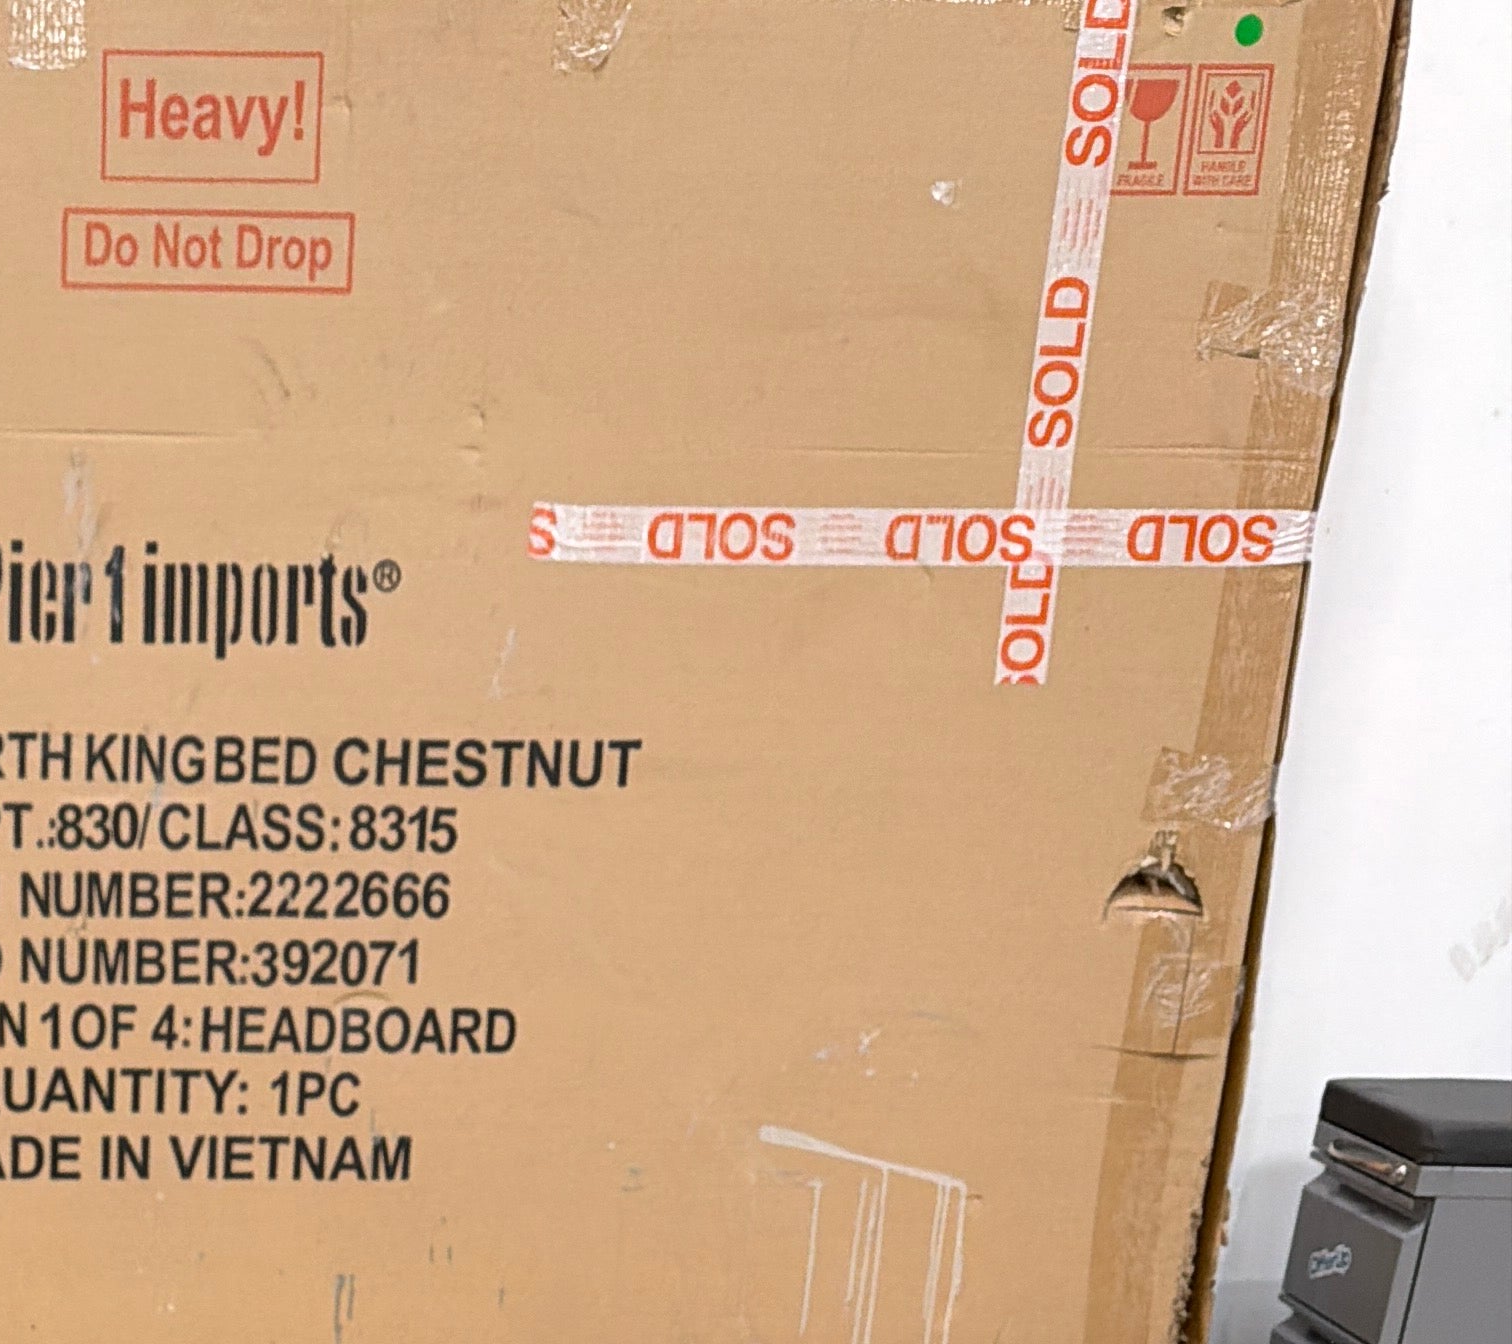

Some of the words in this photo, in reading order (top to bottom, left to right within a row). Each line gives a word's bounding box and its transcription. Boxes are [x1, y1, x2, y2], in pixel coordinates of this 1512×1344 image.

[1065, 0, 1131, 167] SOLD
[119, 77, 306, 156] Heavy!
[85, 221, 138, 267] Do
[154, 222, 222, 269] Not
[236, 224, 332, 282] Drop
[1027, 276, 1090, 447] SOLD
[646, 512, 796, 561] SOLD
[885, 514, 1036, 563] SOLD
[1127, 514, 1278, 563] SOLD
[105, 545, 124, 643] 1
[999, 552, 1054, 684] OLD
[333, 737, 643, 788] CHESTNUT
[20, 870, 451, 919] NUMBER:2222666
[20, 937, 420, 987] NUMBER:392071
[270, 1070, 362, 1118] 1PC
[100, 1135, 150, 1180] IN
[169, 1135, 413, 1181] VIETNAM
